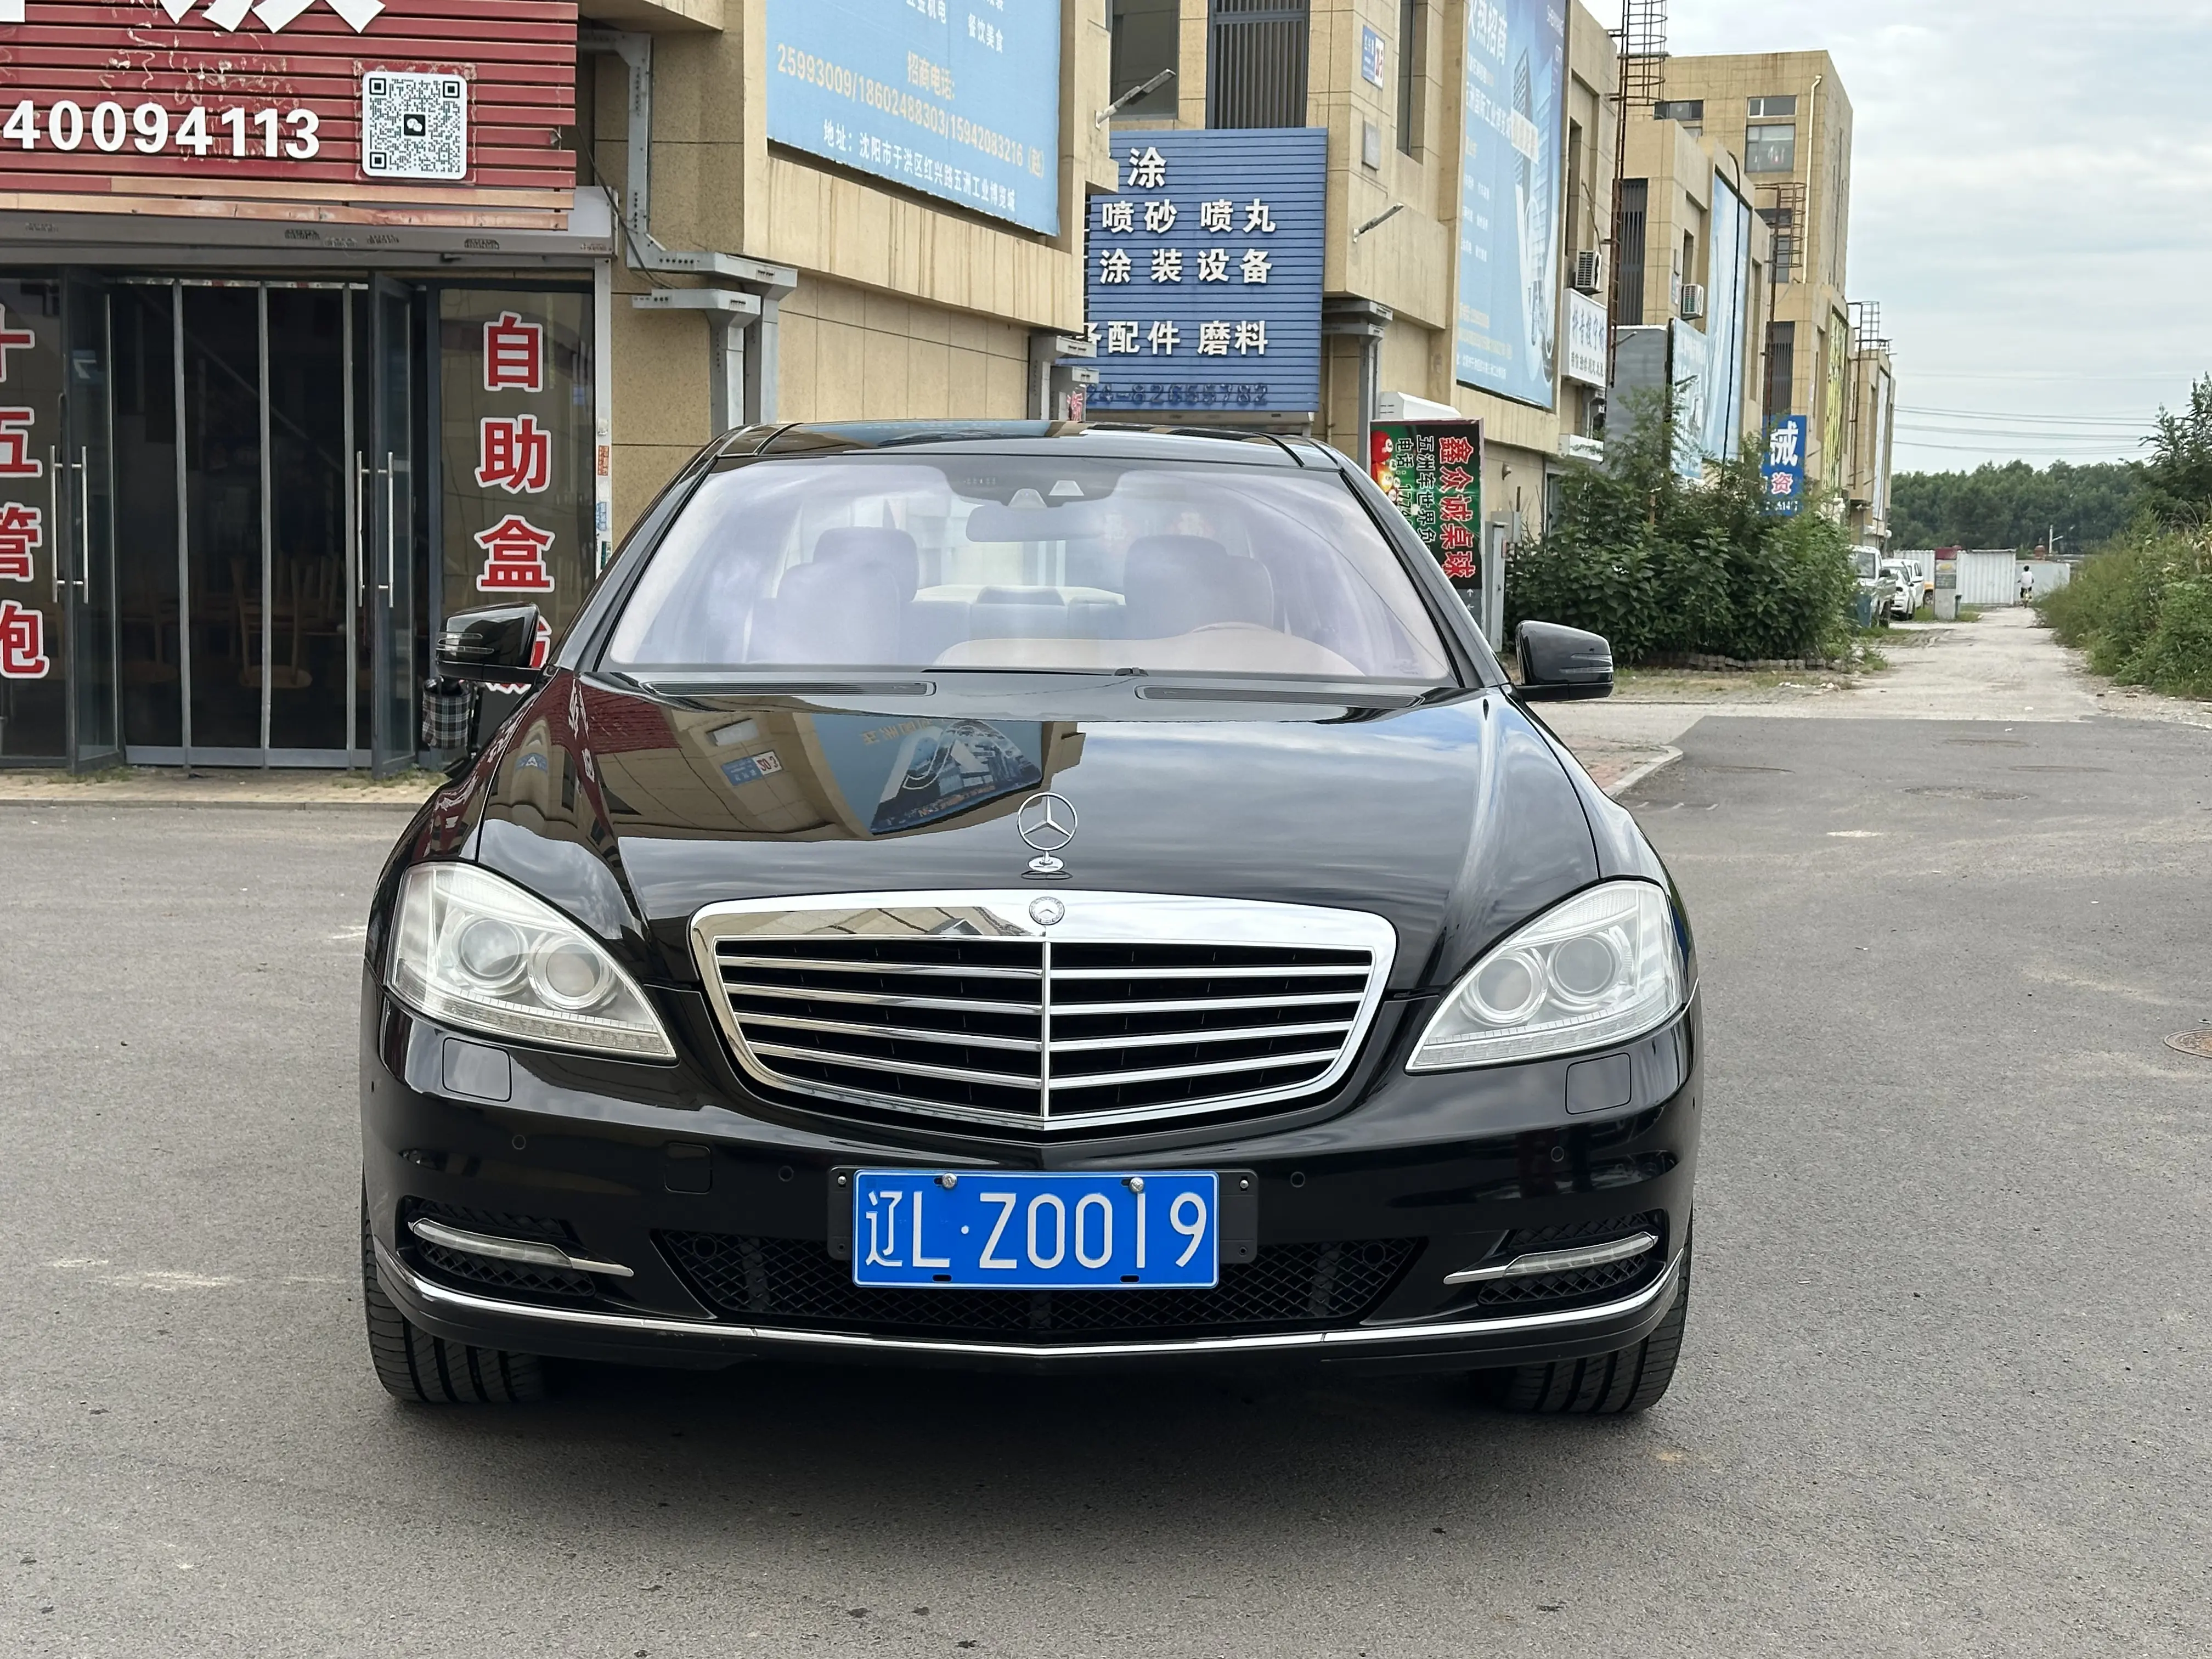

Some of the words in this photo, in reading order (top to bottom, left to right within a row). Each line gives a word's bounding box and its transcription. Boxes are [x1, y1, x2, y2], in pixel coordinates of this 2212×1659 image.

[968, 12, 1003, 53] 餐饮美食
[907, 50, 955, 100] 招商电话:
[3, 100, 321, 159] 40094113
[1127, 146, 1167, 188] 涂
[1102, 198, 1178, 234] 喷砂
[1200, 198, 1277, 234] 喷丸
[1099, 248, 1272, 284] 涂装设备
[1197, 320, 1269, 356] 磨料
[474, 310, 555, 695] 自助盒
[1416, 435, 1436, 544] 五洲车世界负
[1439, 437, 1475, 578] 鑫众诚桌球
